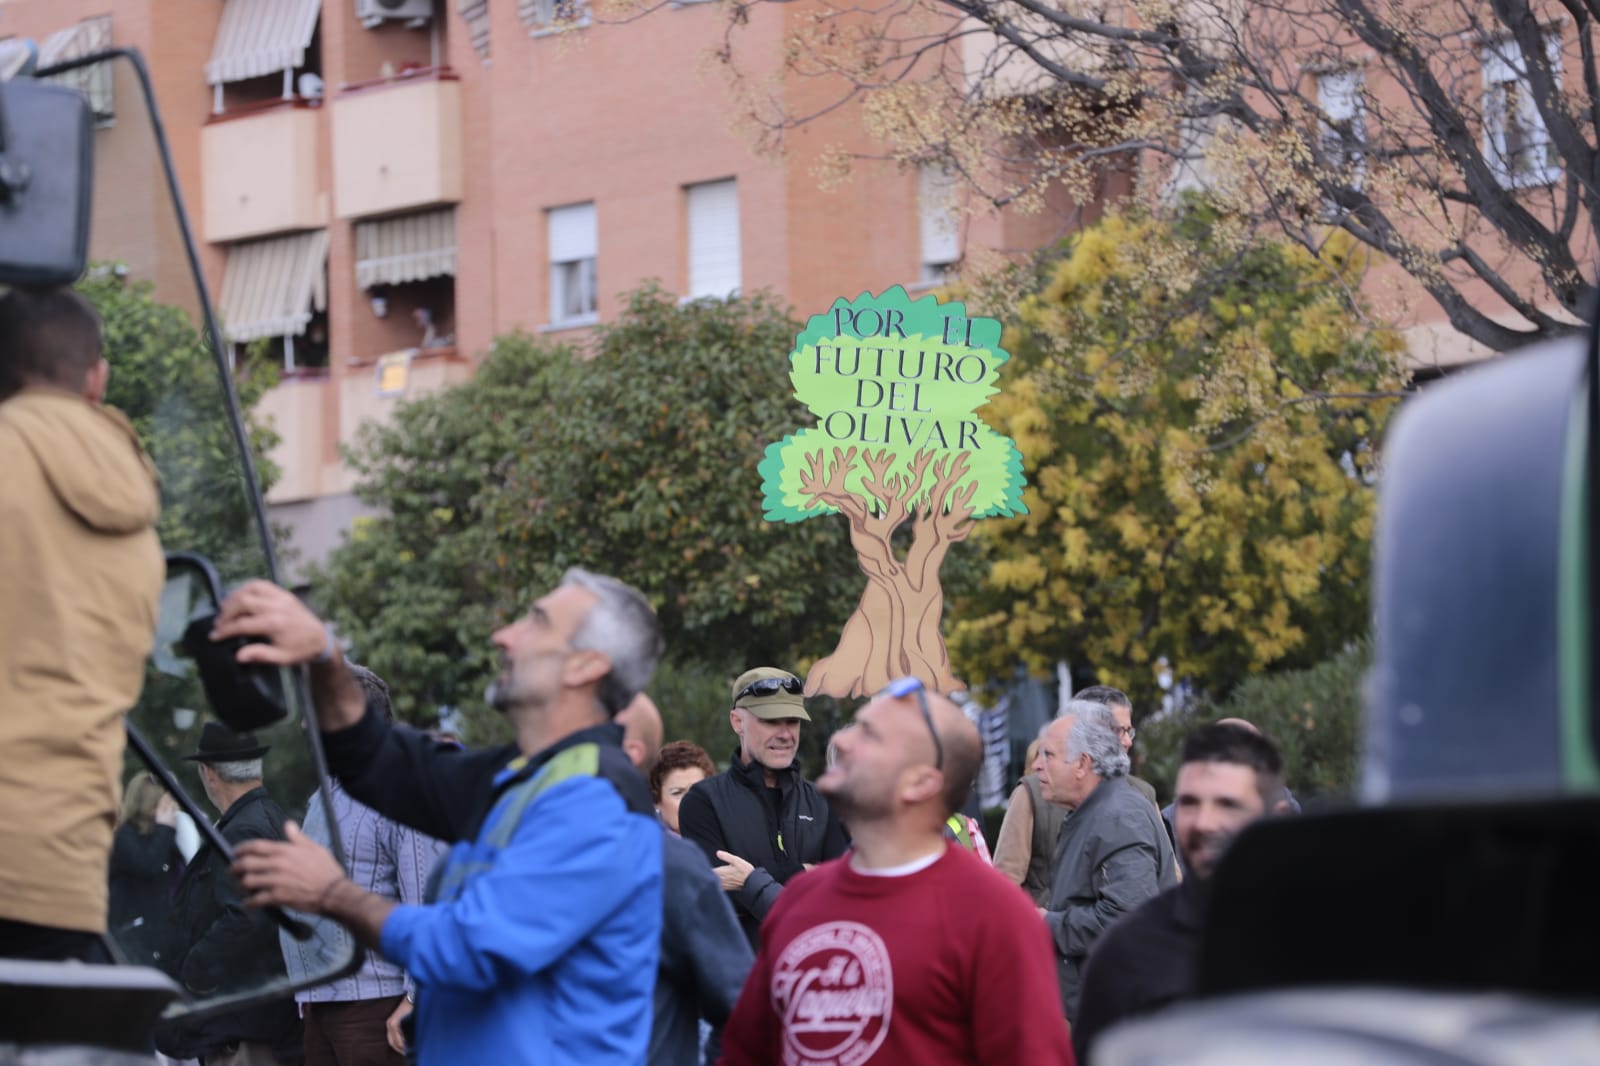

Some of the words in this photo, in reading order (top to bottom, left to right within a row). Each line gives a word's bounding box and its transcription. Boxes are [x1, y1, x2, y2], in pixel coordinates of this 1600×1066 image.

[834, 307, 907, 338] POR
[940, 315, 984, 348] EL
[814, 345, 987, 384] FUTURO
[856, 379, 932, 413] DEL
[824, 410, 981, 449] OLIVAR
